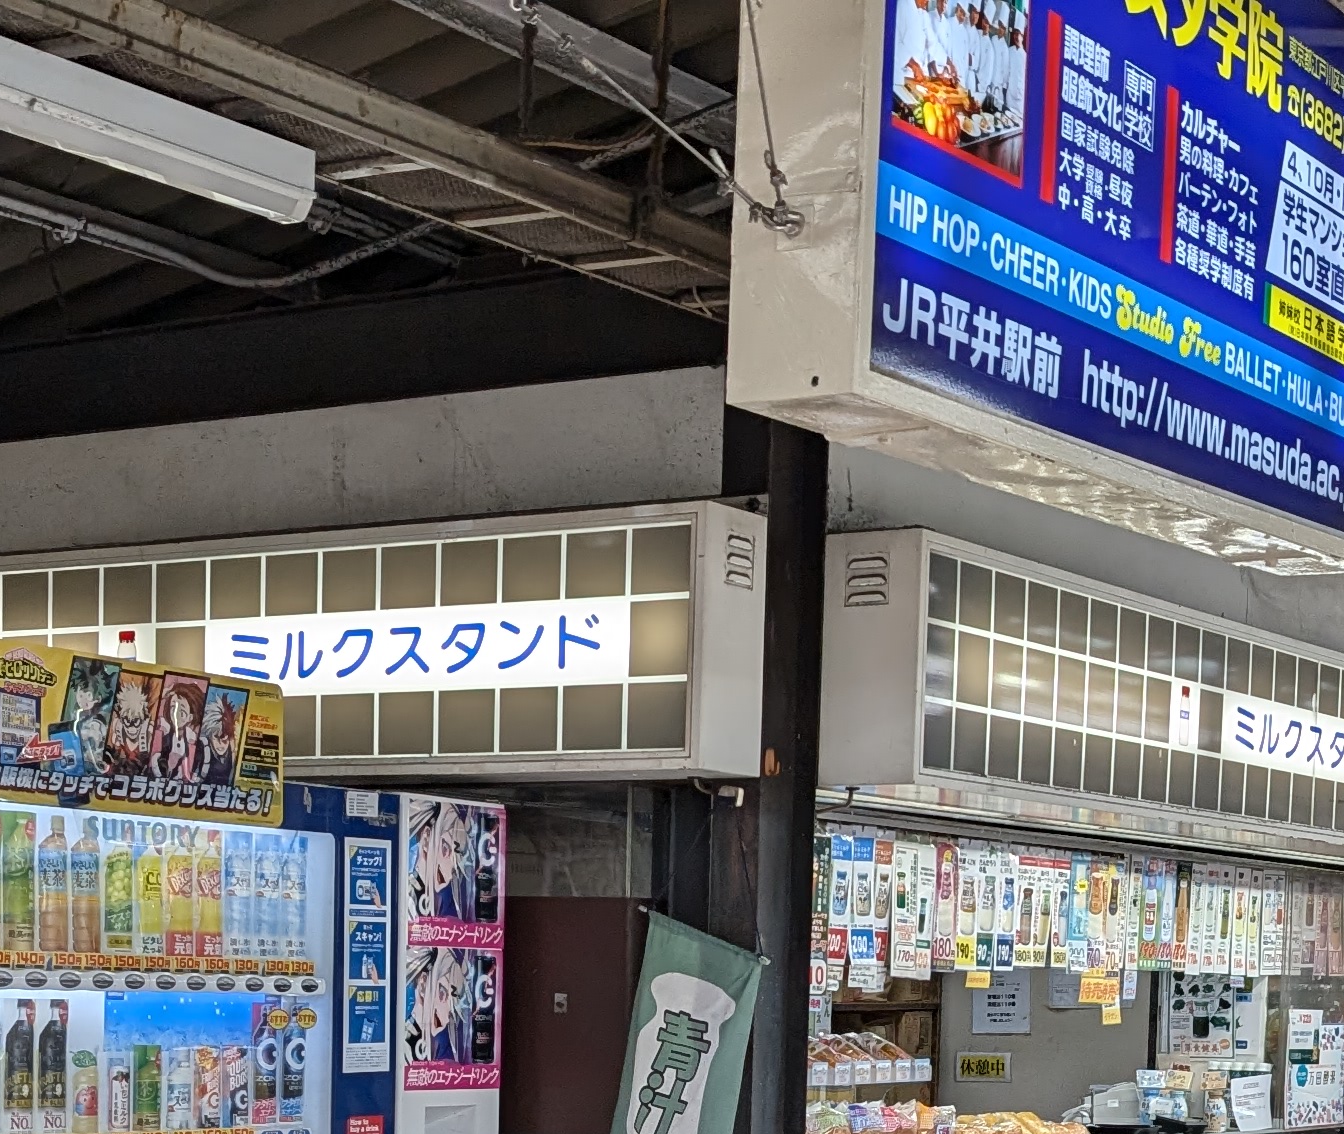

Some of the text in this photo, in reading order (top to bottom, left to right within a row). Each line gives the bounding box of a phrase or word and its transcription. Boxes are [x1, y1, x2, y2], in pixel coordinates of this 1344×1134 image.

[1064, 24, 1110, 82] 調理師
[1061, 66, 1123, 132] 服飾文化
[1181, 101, 1240, 154] カルチャー
[1061, 112, 1135, 174] 国家試験免除
[889, 196, 925, 235] HIP
[1114, 283, 1174, 346] Studio
[1179, 316, 1221, 367] Free
[883, 277, 1062, 399] JR平井駅前
[230, 614, 601, 681] ミルクスタンド
[87, 815, 200, 848] SUNTORY
[409, 924, 503, 945] 無敵のエナジードリンク
[406, 1067, 500, 1088] 無敵のエナジードリンク
[959, 1058, 1005, 1077] 休憩中
